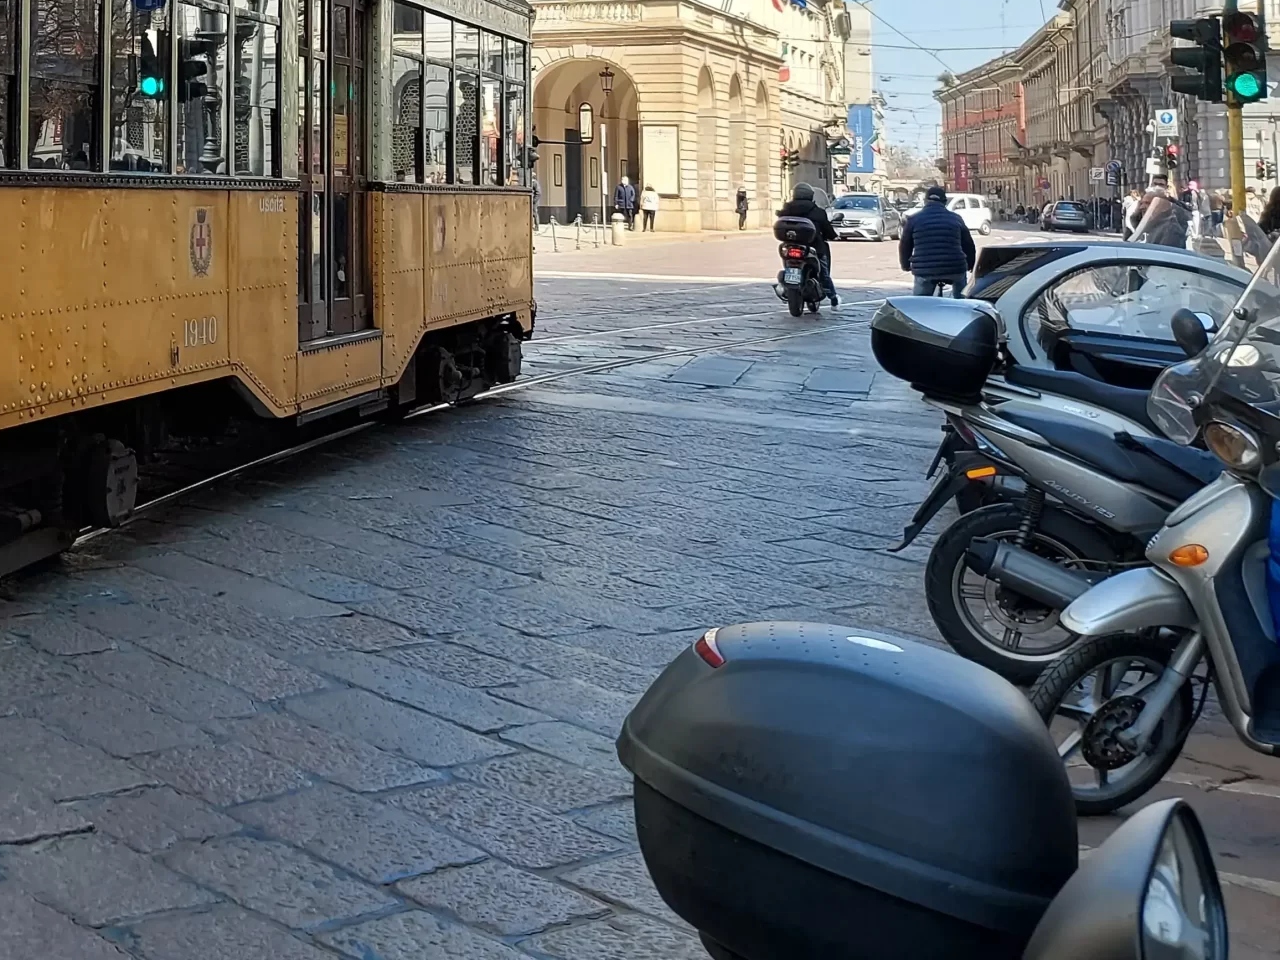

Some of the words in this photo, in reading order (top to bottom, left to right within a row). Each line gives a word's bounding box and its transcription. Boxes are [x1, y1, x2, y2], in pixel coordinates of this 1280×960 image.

[259, 194, 284, 213] uscita
[184, 315, 217, 347] 1940
[1093, 504, 1116, 519] 125
